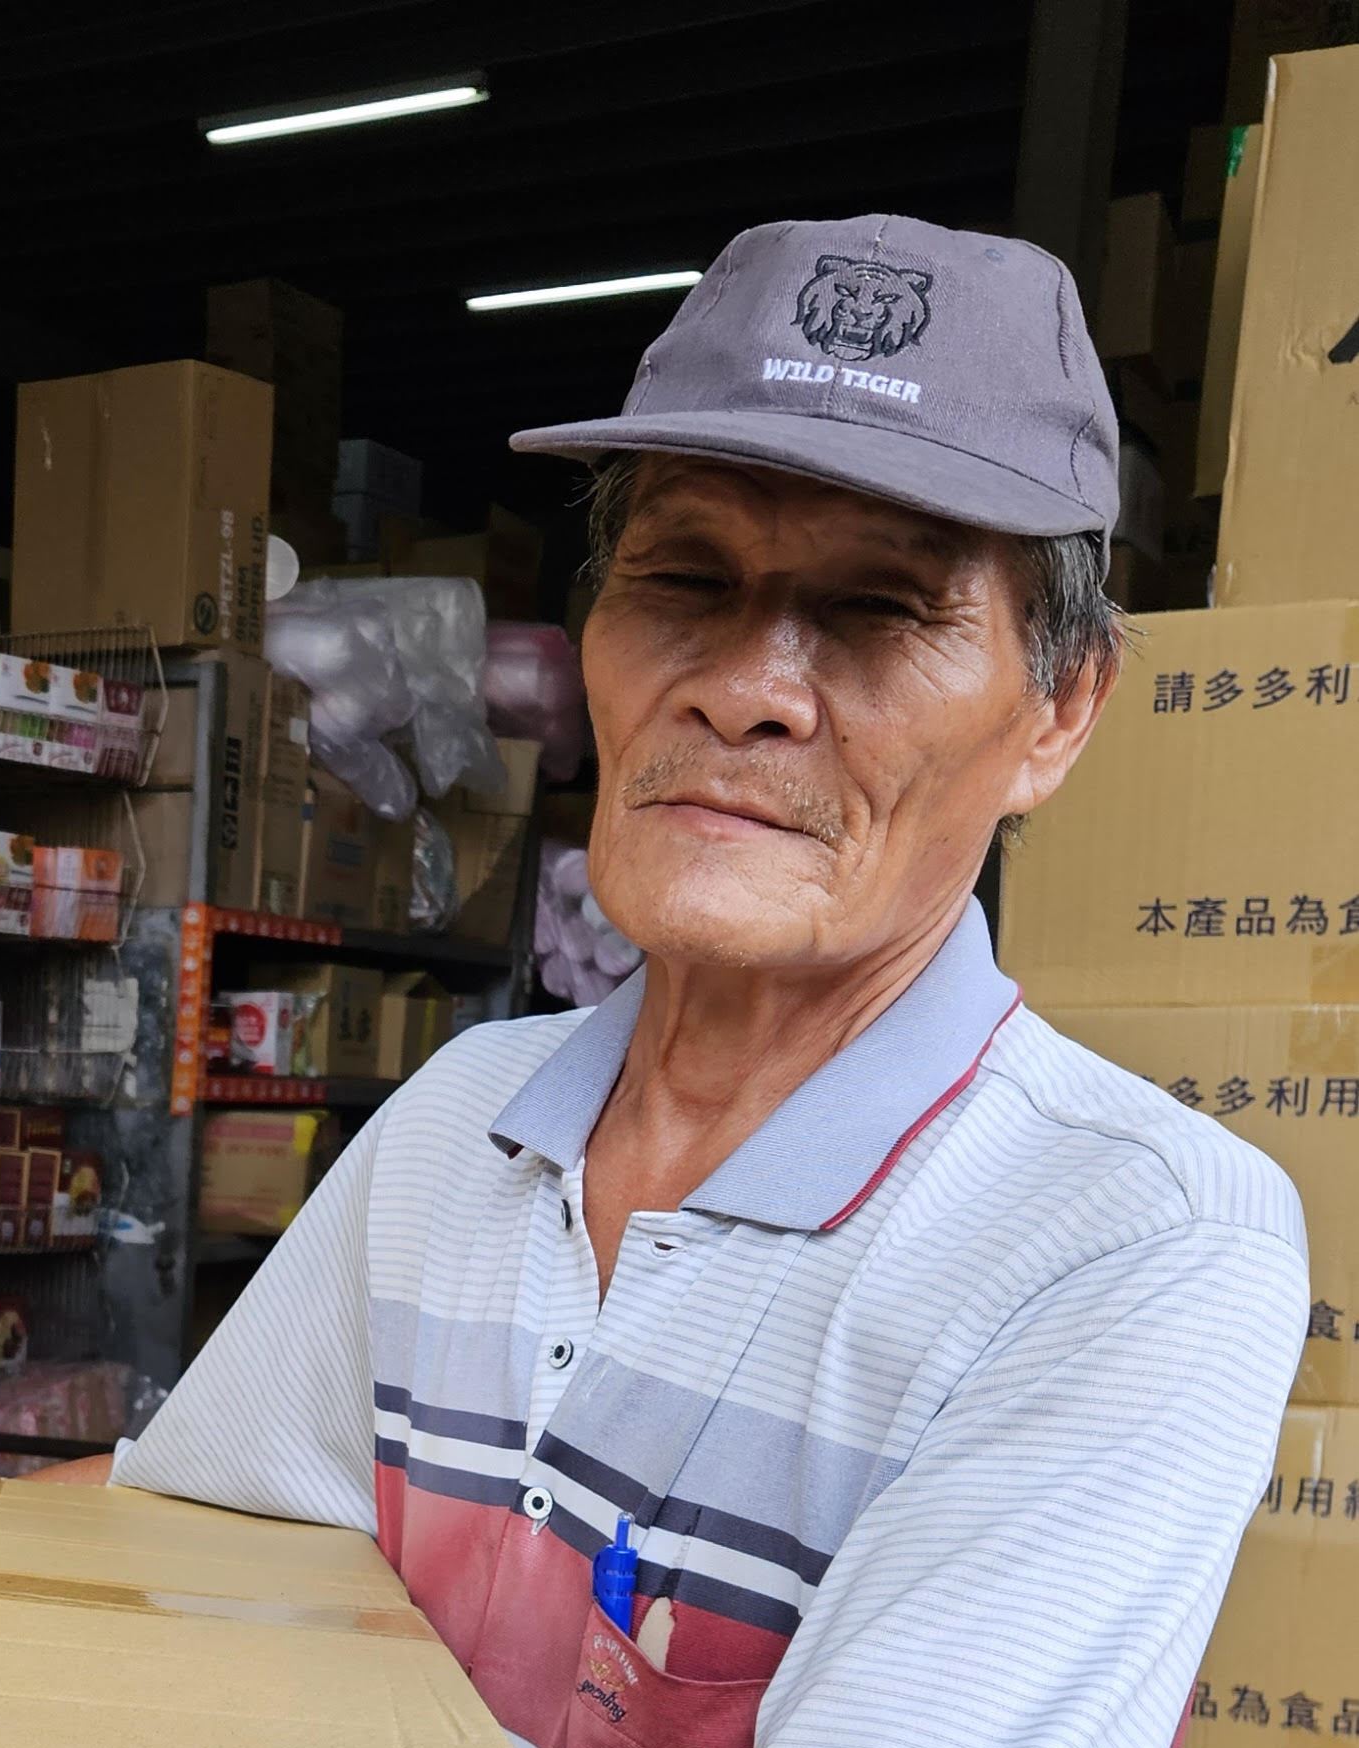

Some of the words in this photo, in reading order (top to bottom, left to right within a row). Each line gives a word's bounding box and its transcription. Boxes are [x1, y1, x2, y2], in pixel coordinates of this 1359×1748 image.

[762, 358, 835, 383] WILD
[840, 367, 922, 403] TIGER
[1153, 663, 1359, 713] 請多多利
[1141, 1075, 1359, 1118] 多多利用
